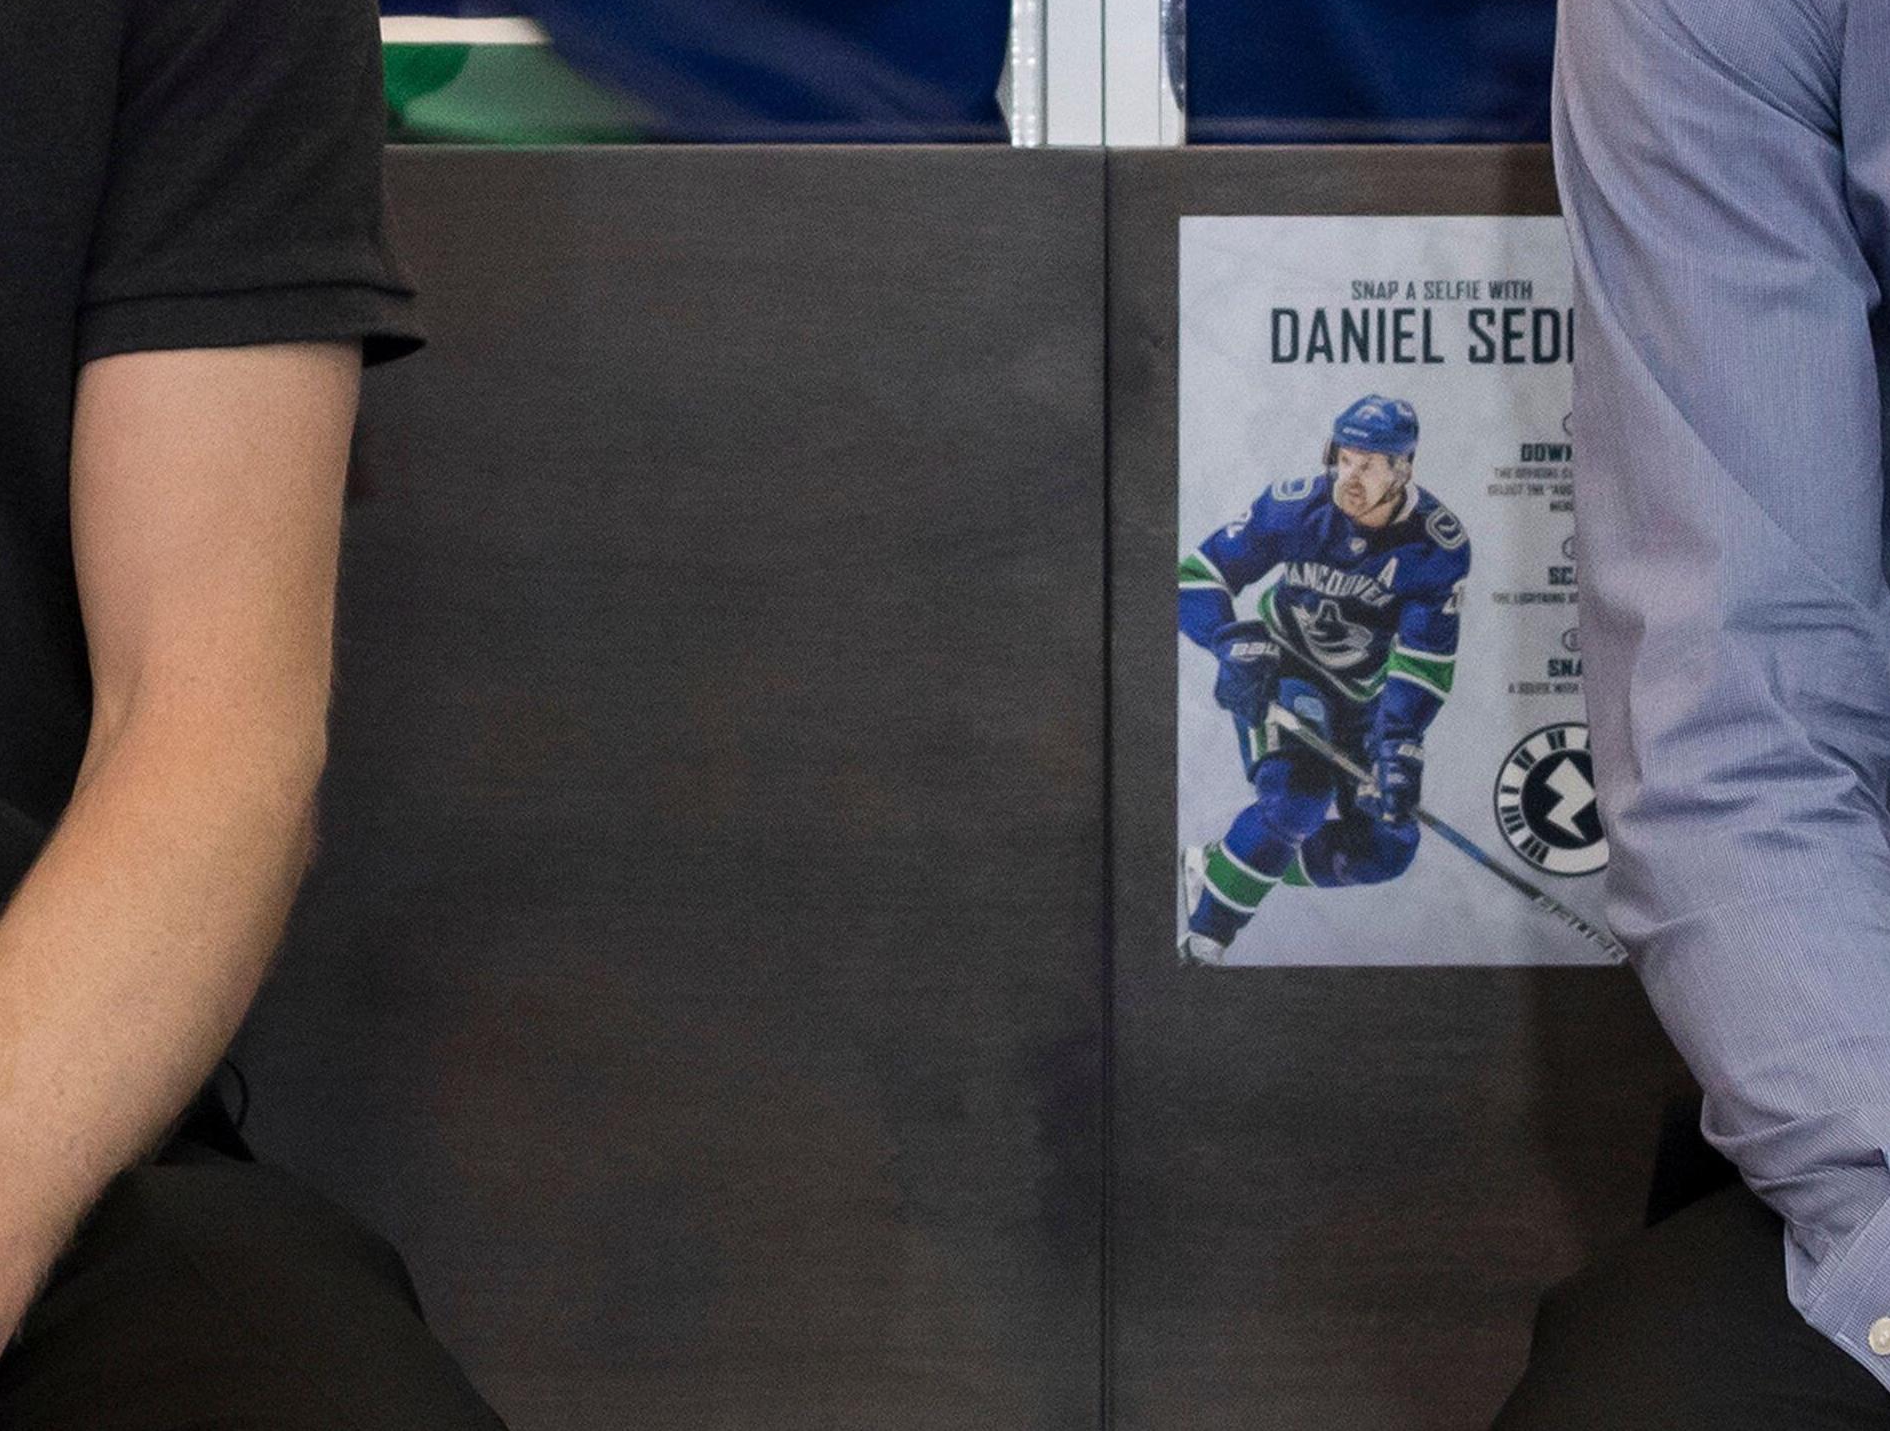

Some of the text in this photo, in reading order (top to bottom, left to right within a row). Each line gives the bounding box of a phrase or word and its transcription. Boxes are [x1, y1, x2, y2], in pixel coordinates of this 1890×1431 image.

[1351, 280, 1533, 301] SNAP A SELFIE WITH
[1270, 306, 1445, 365] DANIEL
[1548, 566, 1578, 586] SC
